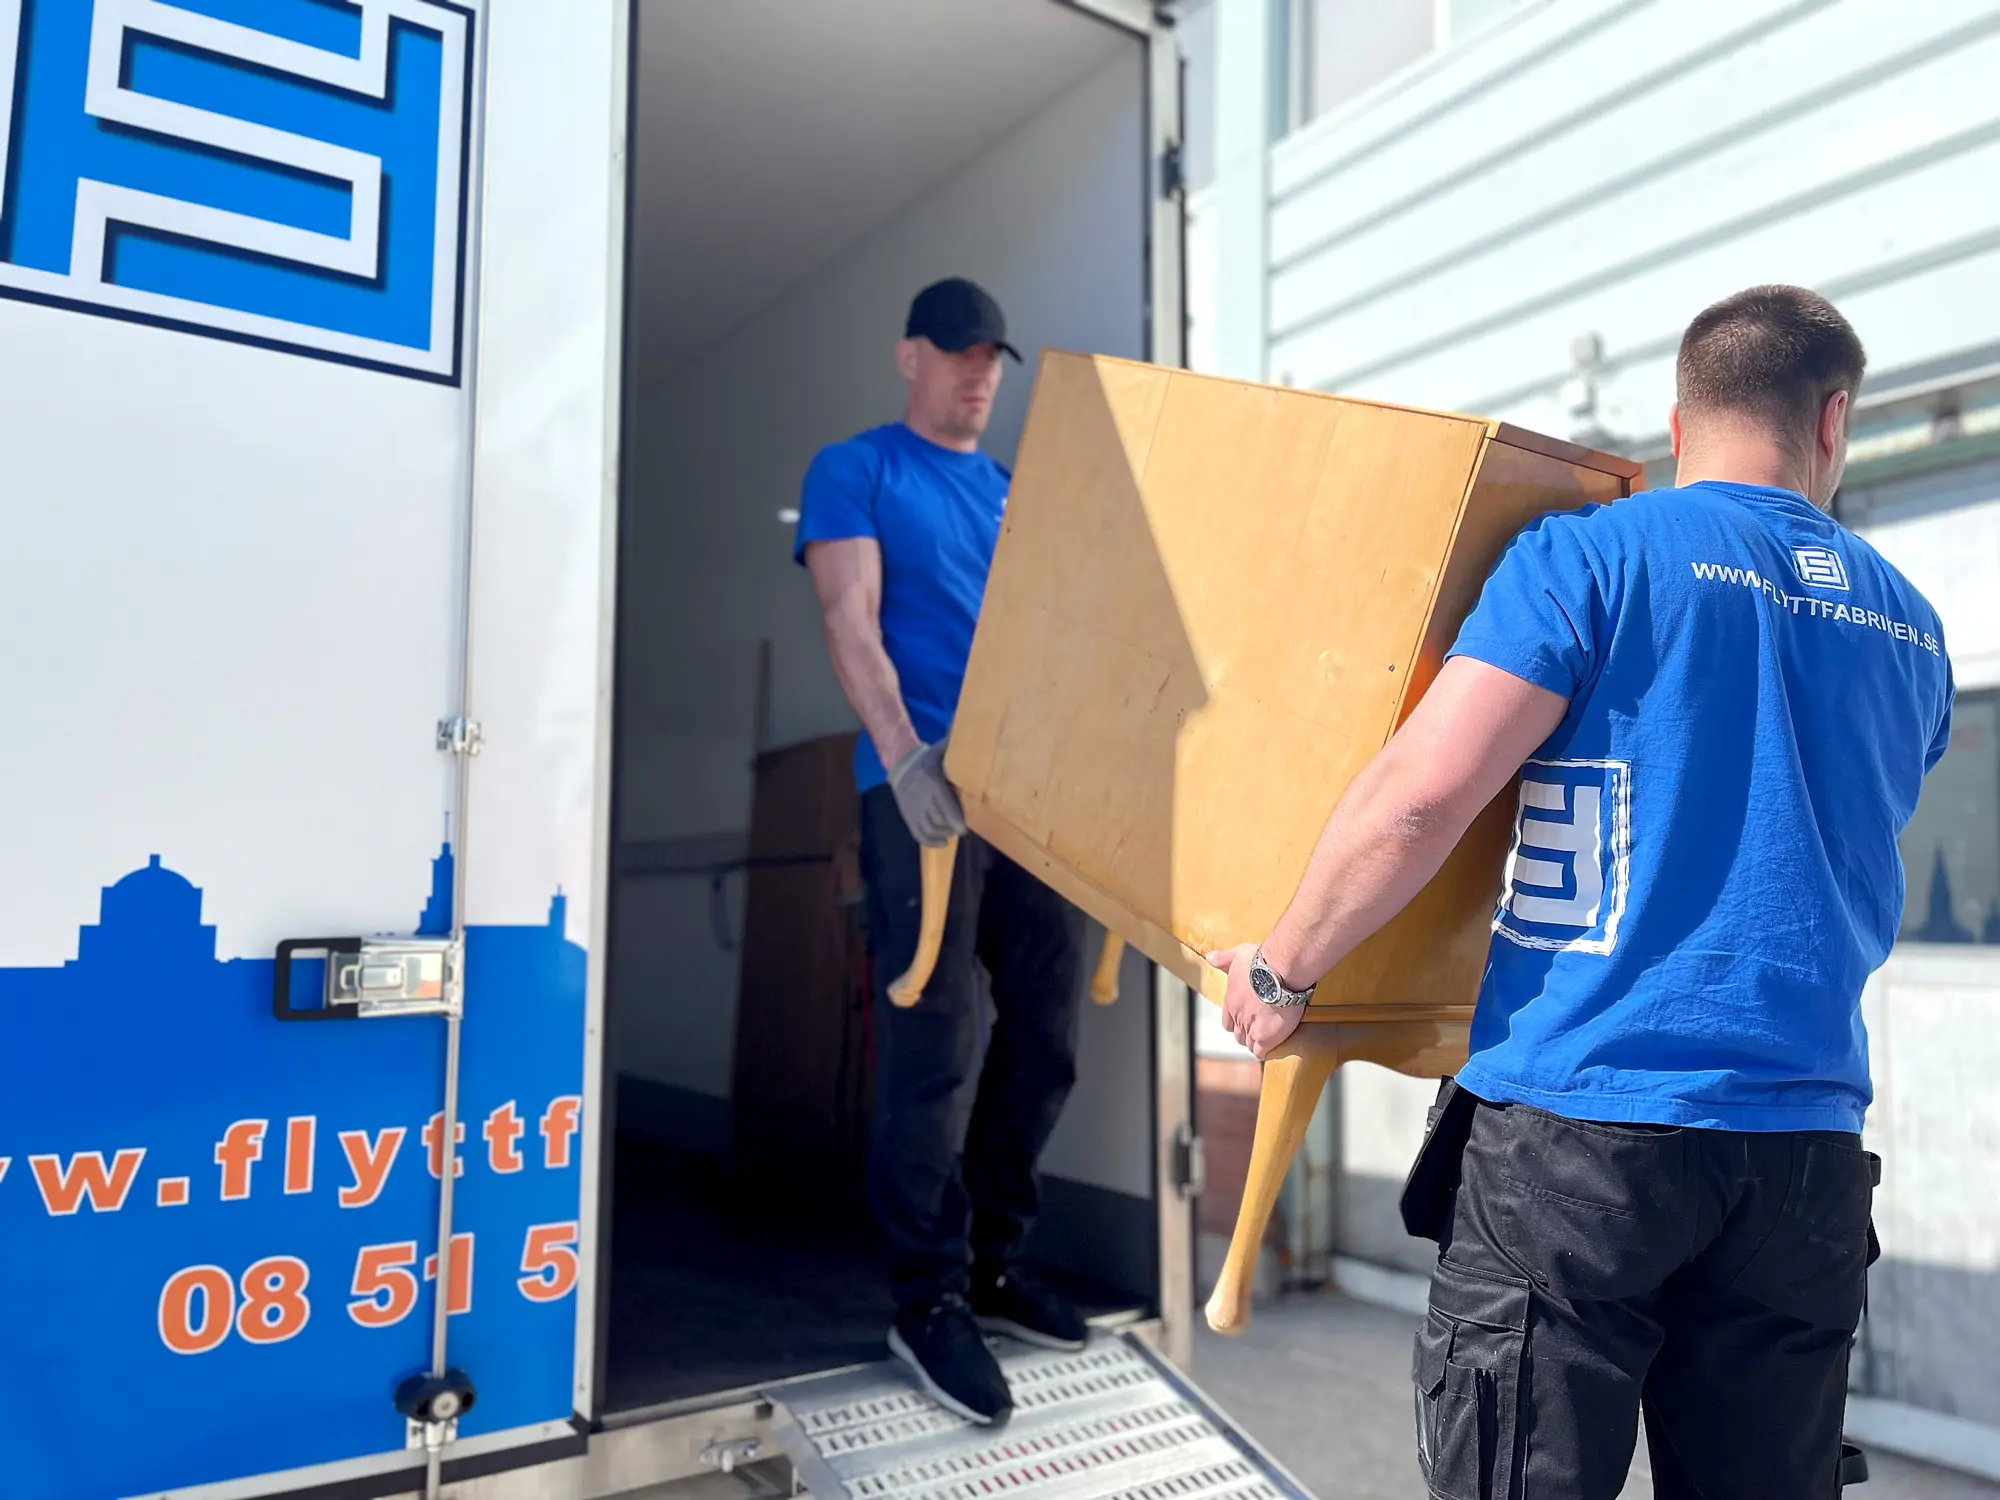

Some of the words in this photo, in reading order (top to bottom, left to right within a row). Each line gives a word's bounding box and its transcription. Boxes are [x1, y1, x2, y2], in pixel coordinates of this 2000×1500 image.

[1690, 561, 1940, 657] WWWFLYTTFABRIKEN.SE
[0, 1096, 582, 1217] w.flyttf
[157, 1255, 311, 1355] 08
[346, 1231, 475, 1328] 51
[516, 1220, 580, 1303] 5
